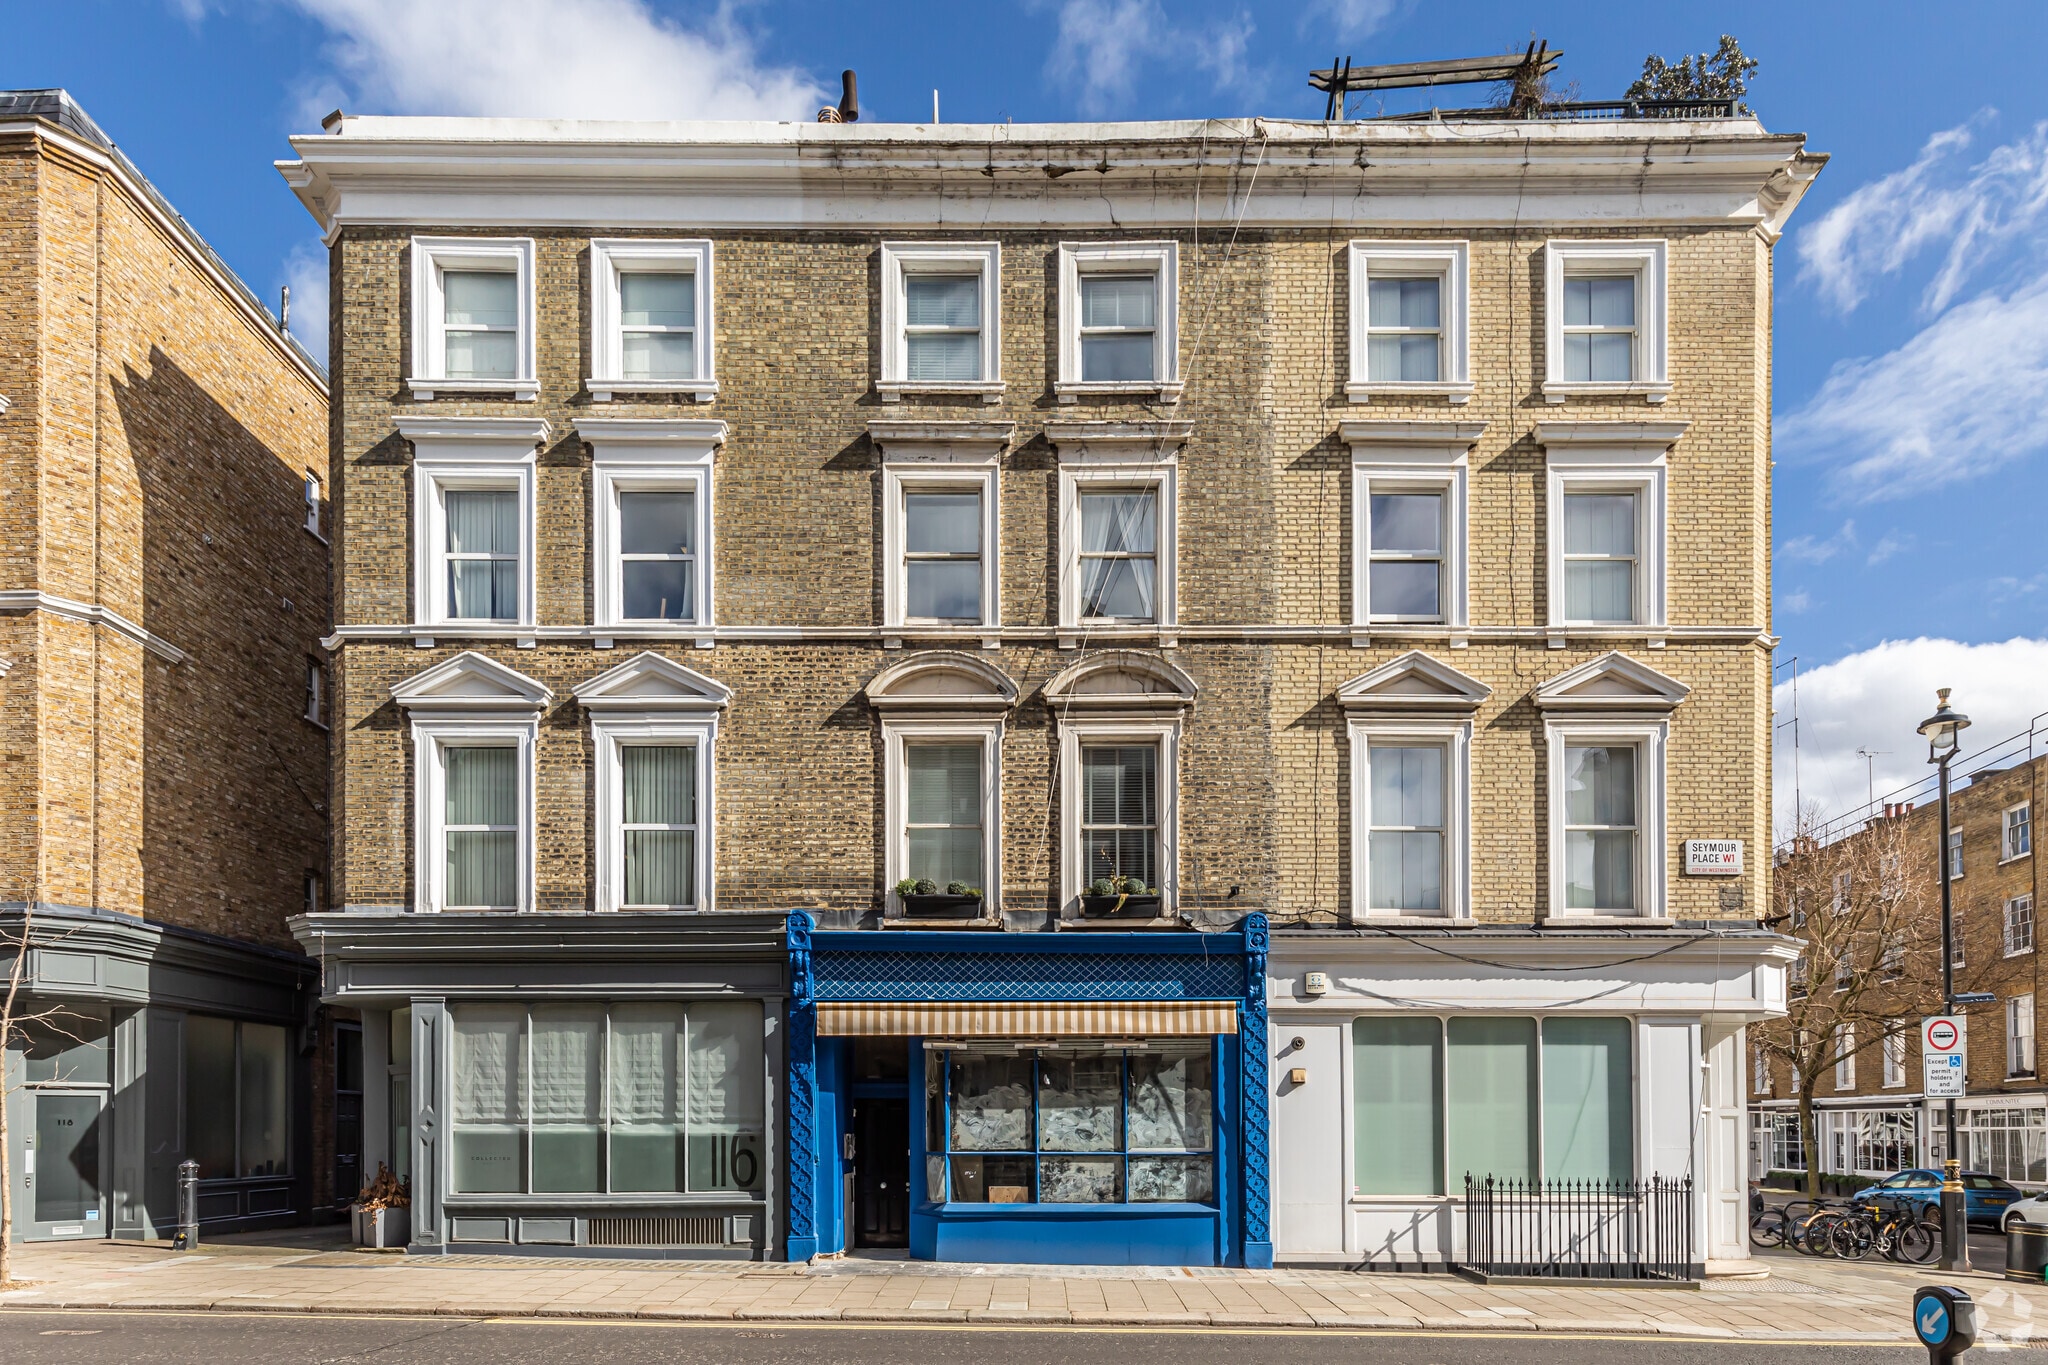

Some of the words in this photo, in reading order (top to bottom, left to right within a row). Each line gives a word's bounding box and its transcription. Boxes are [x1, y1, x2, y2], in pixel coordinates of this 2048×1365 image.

[1692, 842, 1737, 852] SEYMOUR
[1692, 854, 1720, 863] PLACE
[1722, 853, 1735, 863] W1
[711, 1128, 757, 1187] 116
